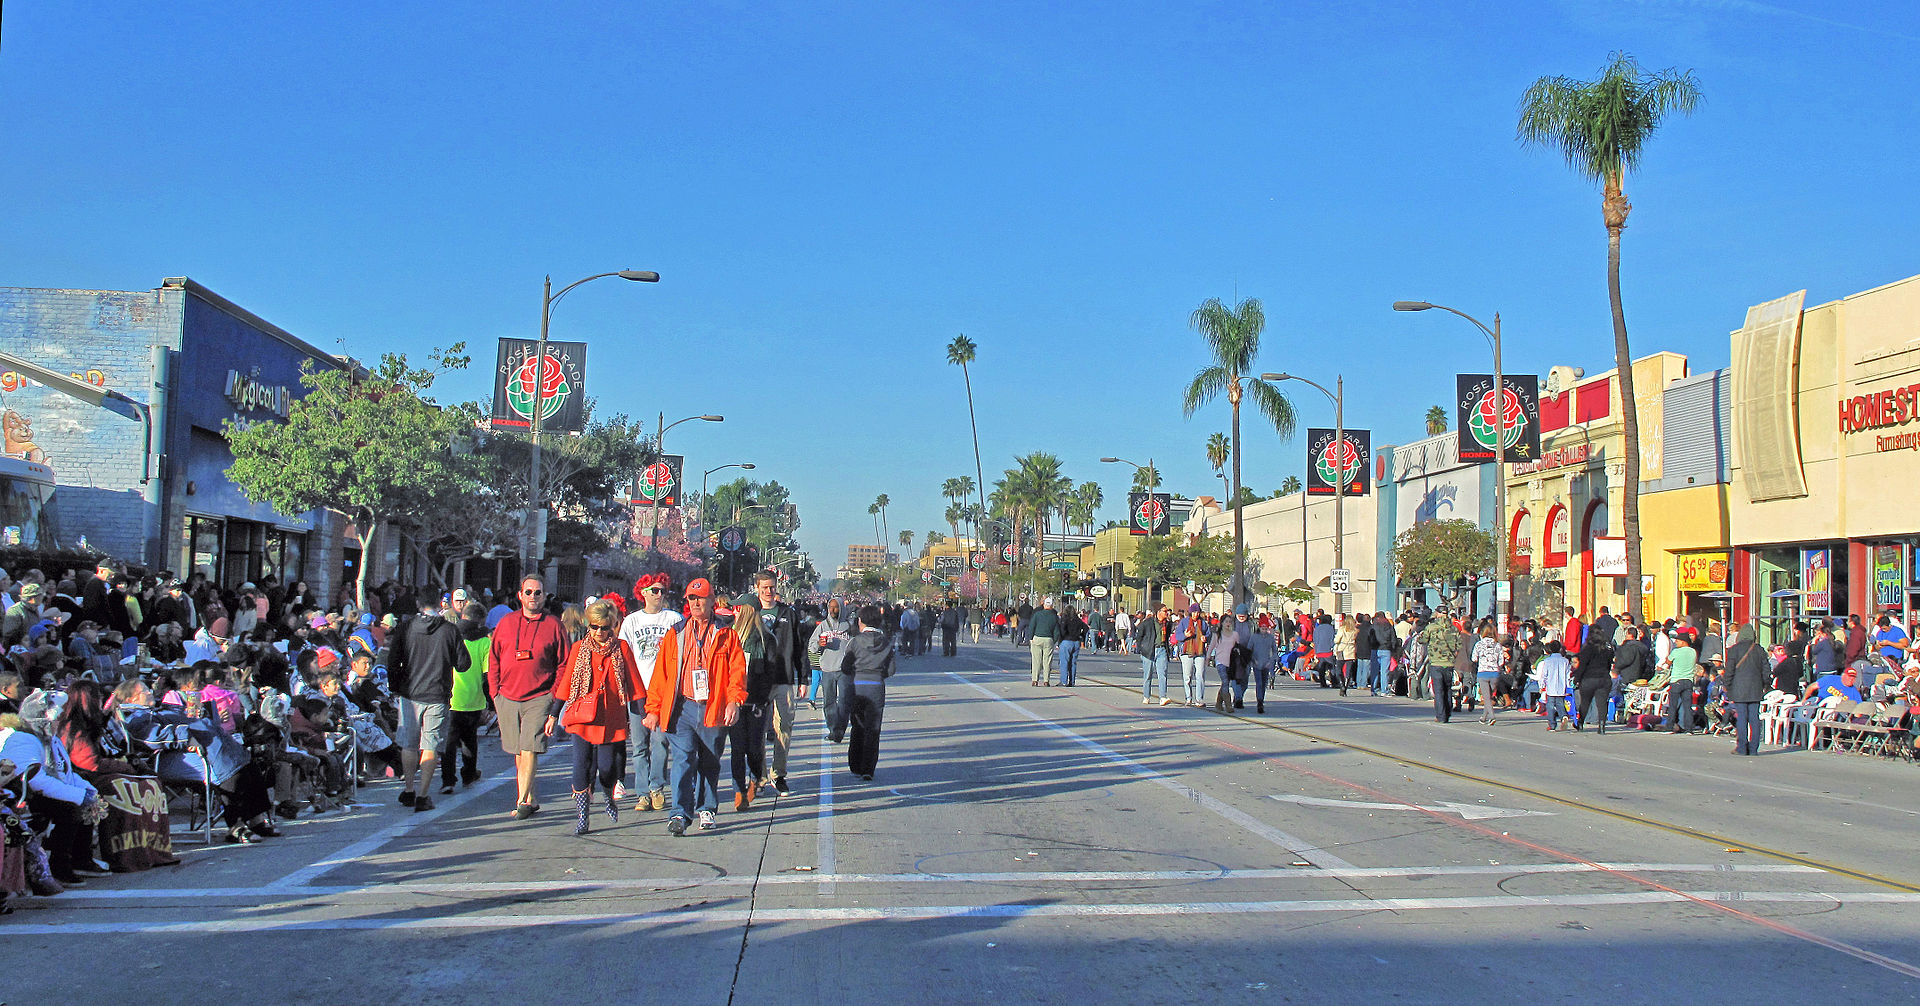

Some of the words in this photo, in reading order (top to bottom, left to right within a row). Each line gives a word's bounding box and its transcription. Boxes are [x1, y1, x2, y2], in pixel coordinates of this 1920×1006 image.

[500, 345, 533, 375] ROSE
[546, 346, 583, 389] PARADE
[1461, 380, 1490, 410] ROSE
[1503, 379, 1539, 420] PARADE
[1310, 433, 1333, 455] ROSE
[1332, 581, 1348, 591] 30
[1876, 581, 1901, 605] Sale
[634, 627, 651, 639] BIG
